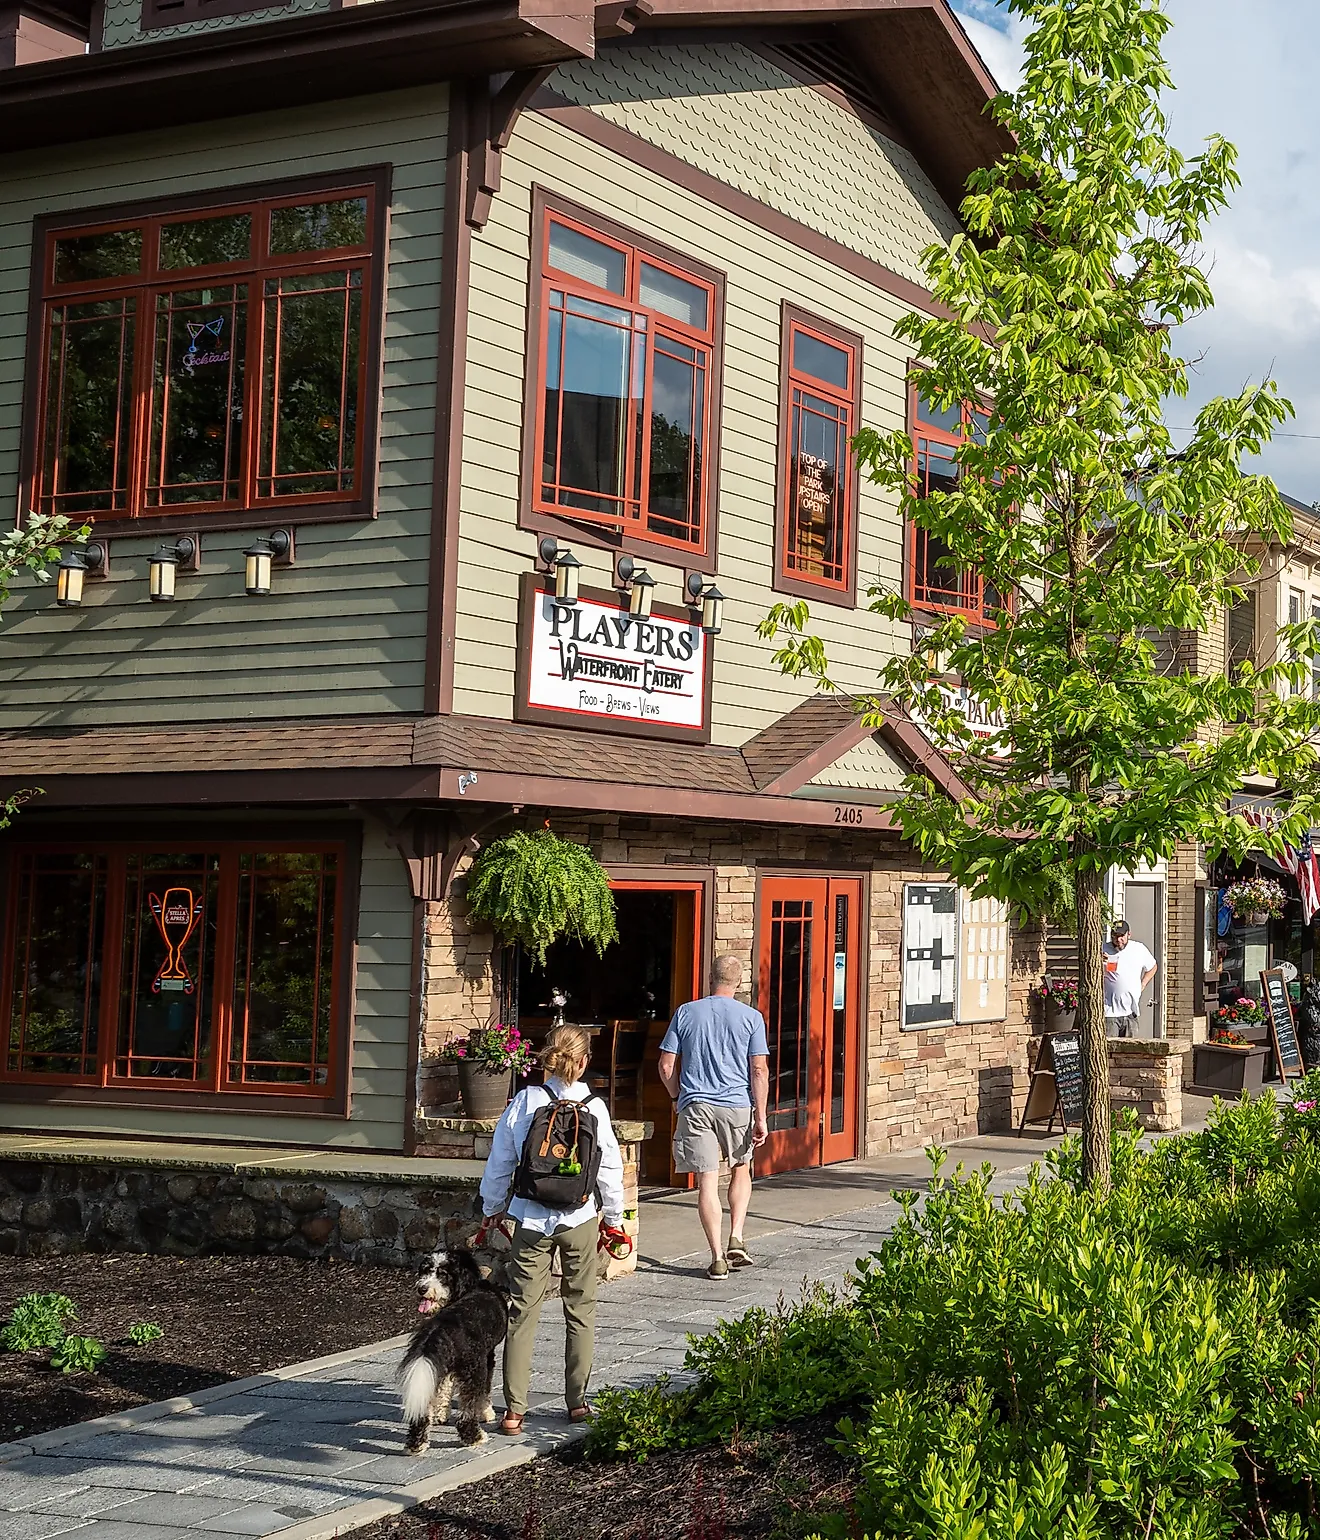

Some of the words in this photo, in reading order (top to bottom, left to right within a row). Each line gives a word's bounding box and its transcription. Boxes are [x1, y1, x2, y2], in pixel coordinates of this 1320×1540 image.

[182, 351, 230, 366] Cocktail
[800, 452, 816, 466] TOP
[817, 458, 828, 469] OF
[807, 465, 822, 480] THE
[805, 475, 823, 491] PARK
[803, 499, 823, 513] OPEN
[549, 604, 693, 661] PLAYERS
[557, 639, 640, 681] WATERFRONT
[642, 659, 684, 694] EATERY
[834, 807, 863, 825] 2405
